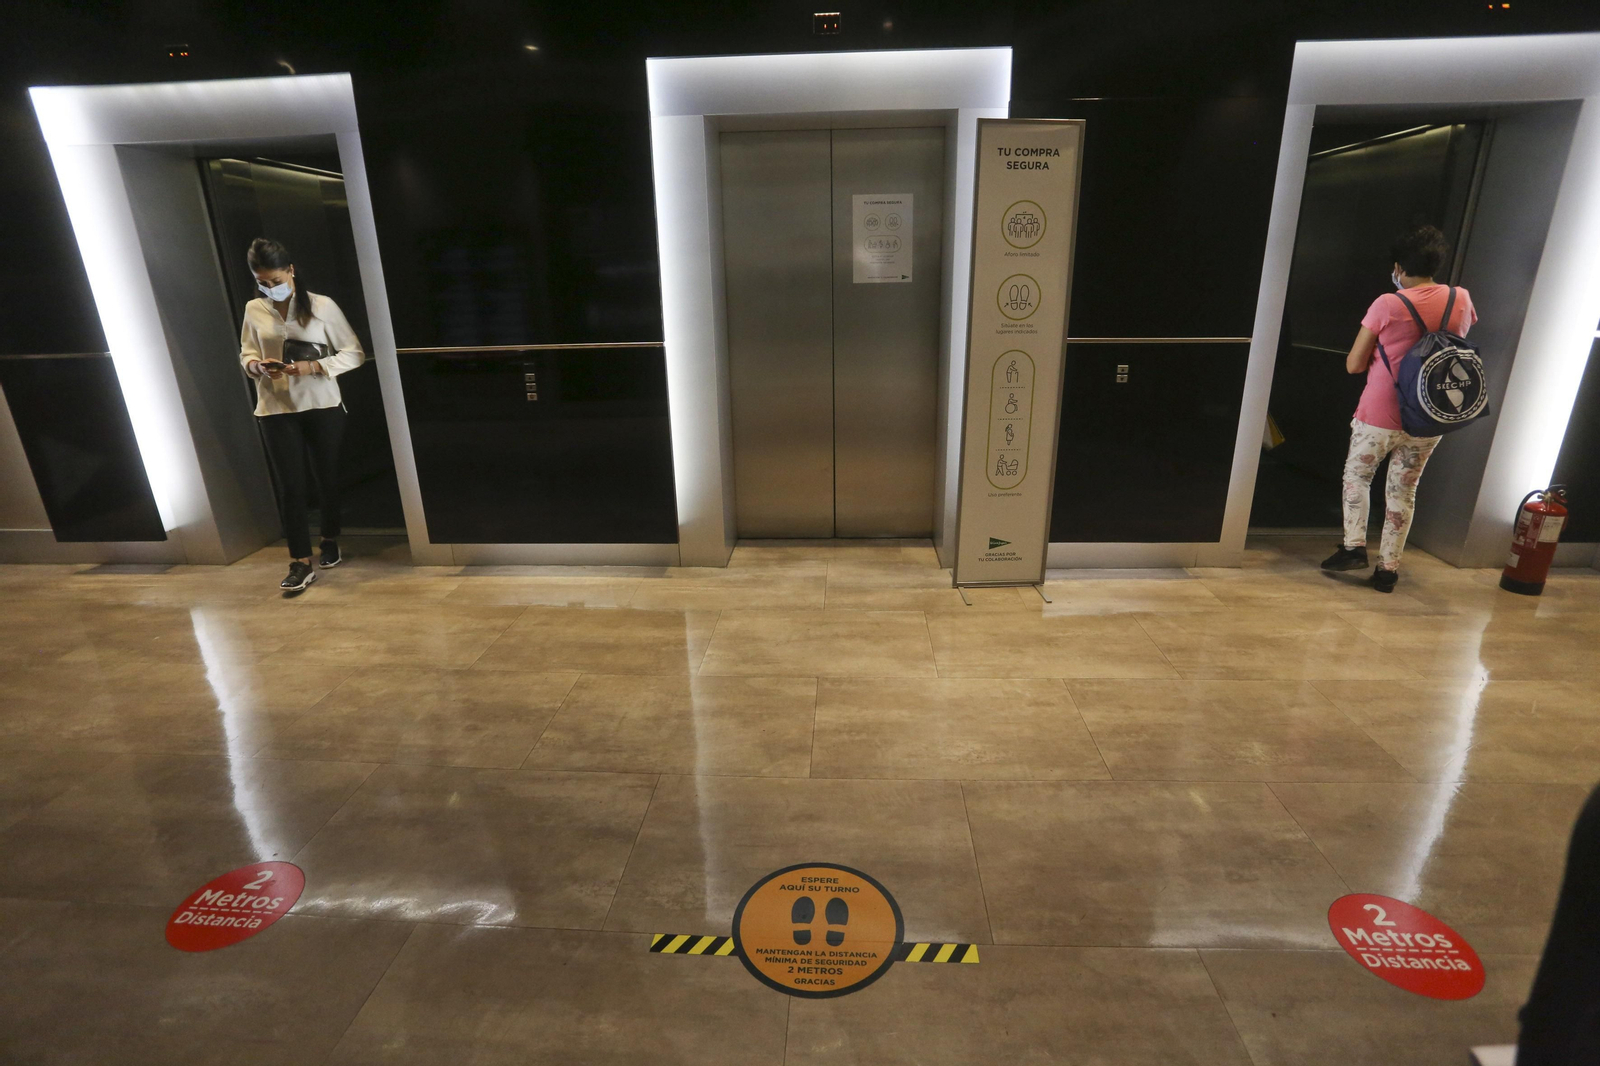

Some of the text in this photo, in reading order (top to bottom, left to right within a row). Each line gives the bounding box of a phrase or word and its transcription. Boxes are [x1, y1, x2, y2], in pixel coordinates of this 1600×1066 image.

[998, 148, 1060, 156] TU COMPRA
[1007, 161, 1049, 170] SEGURA
[243, 871, 273, 890] 2
[194, 889, 283, 910] Metros
[174, 911, 262, 929] Distancia
[1363, 904, 1396, 926] 2
[1342, 927, 1452, 948] Metros
[765, 956, 797, 964] MÍNIMA
[1362, 953, 1471, 971] Distancia
[798, 967, 843, 975] METROS
